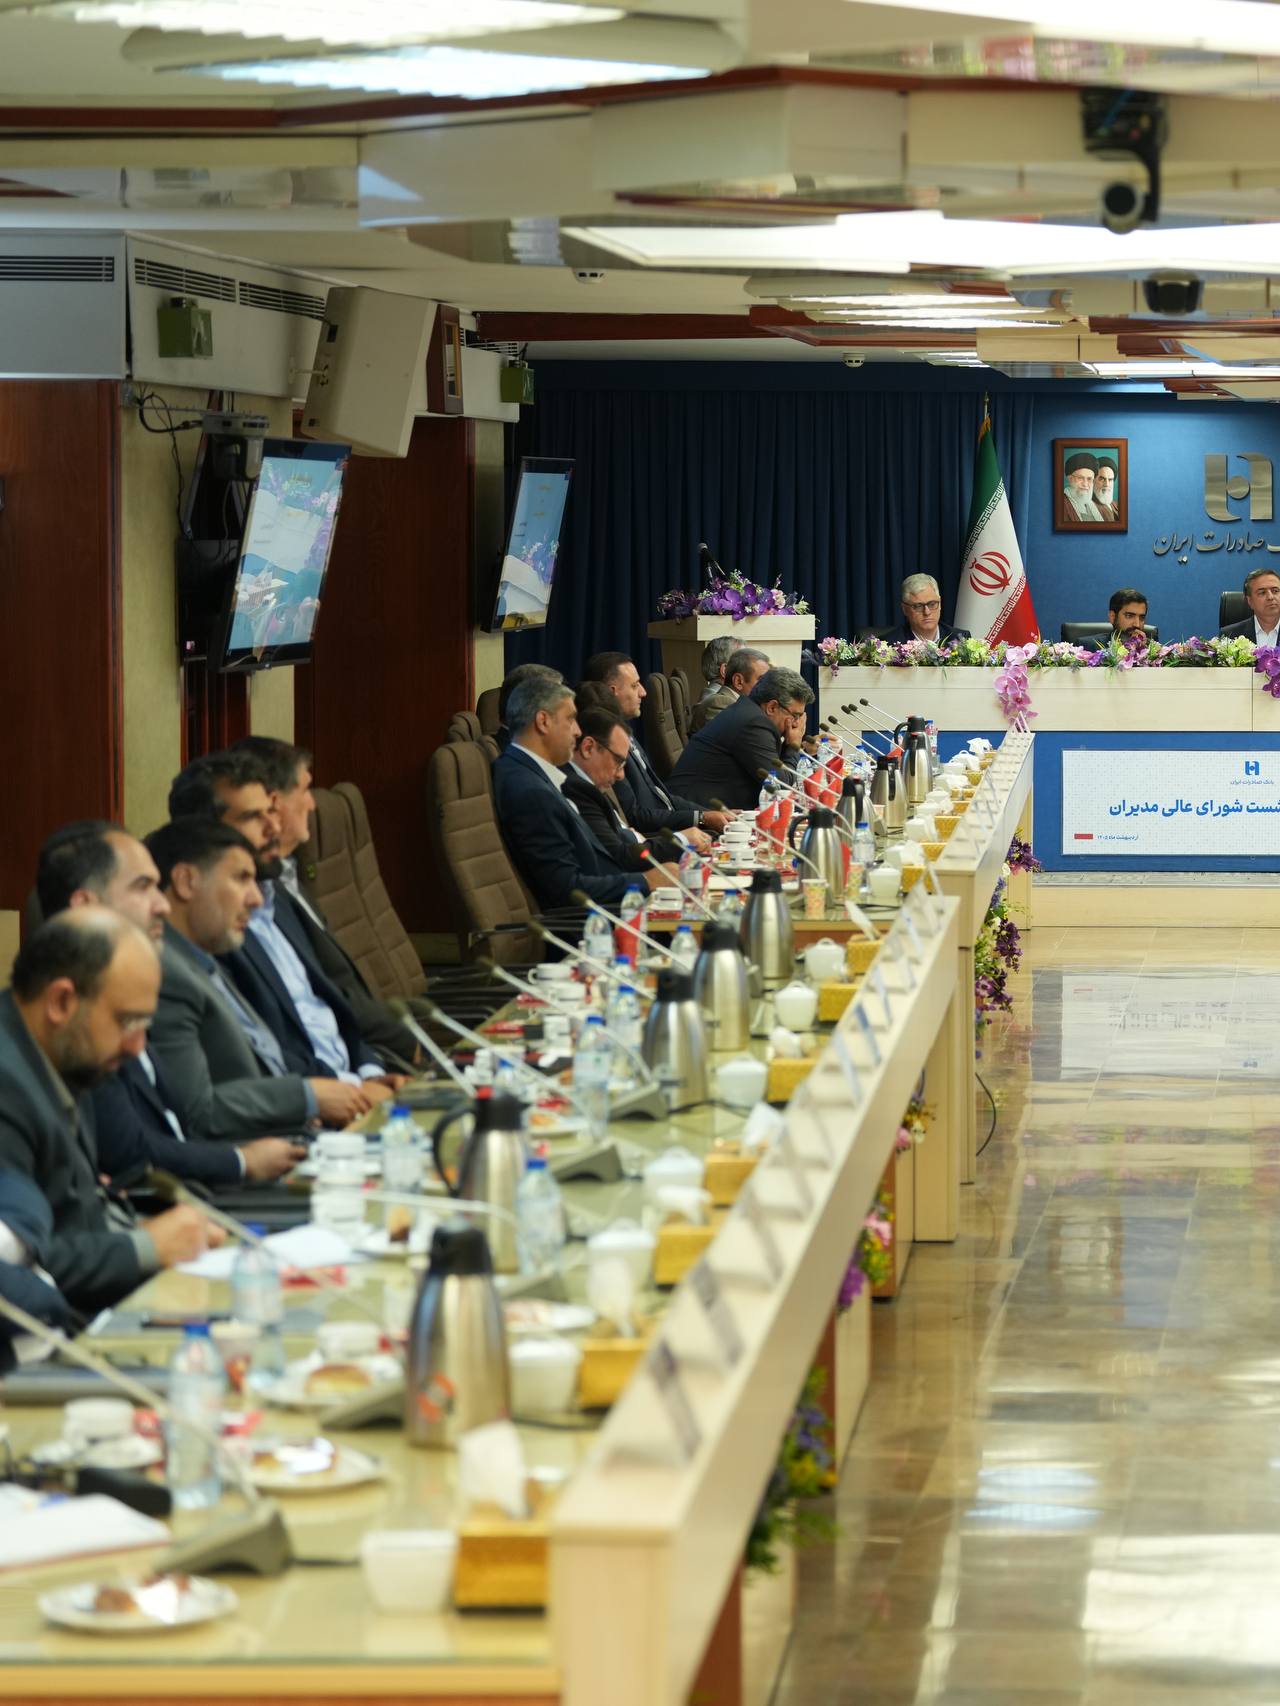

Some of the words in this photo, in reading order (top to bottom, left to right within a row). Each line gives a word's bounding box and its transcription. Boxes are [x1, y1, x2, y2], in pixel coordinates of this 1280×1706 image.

[1153, 533, 1194, 565] ایران
[1196, 531, 1264, 553] صادرات
[1109, 799, 1159, 817] مدیران
[1161, 799, 1193, 817] عالی
[1195, 799, 1243, 817] شورای
